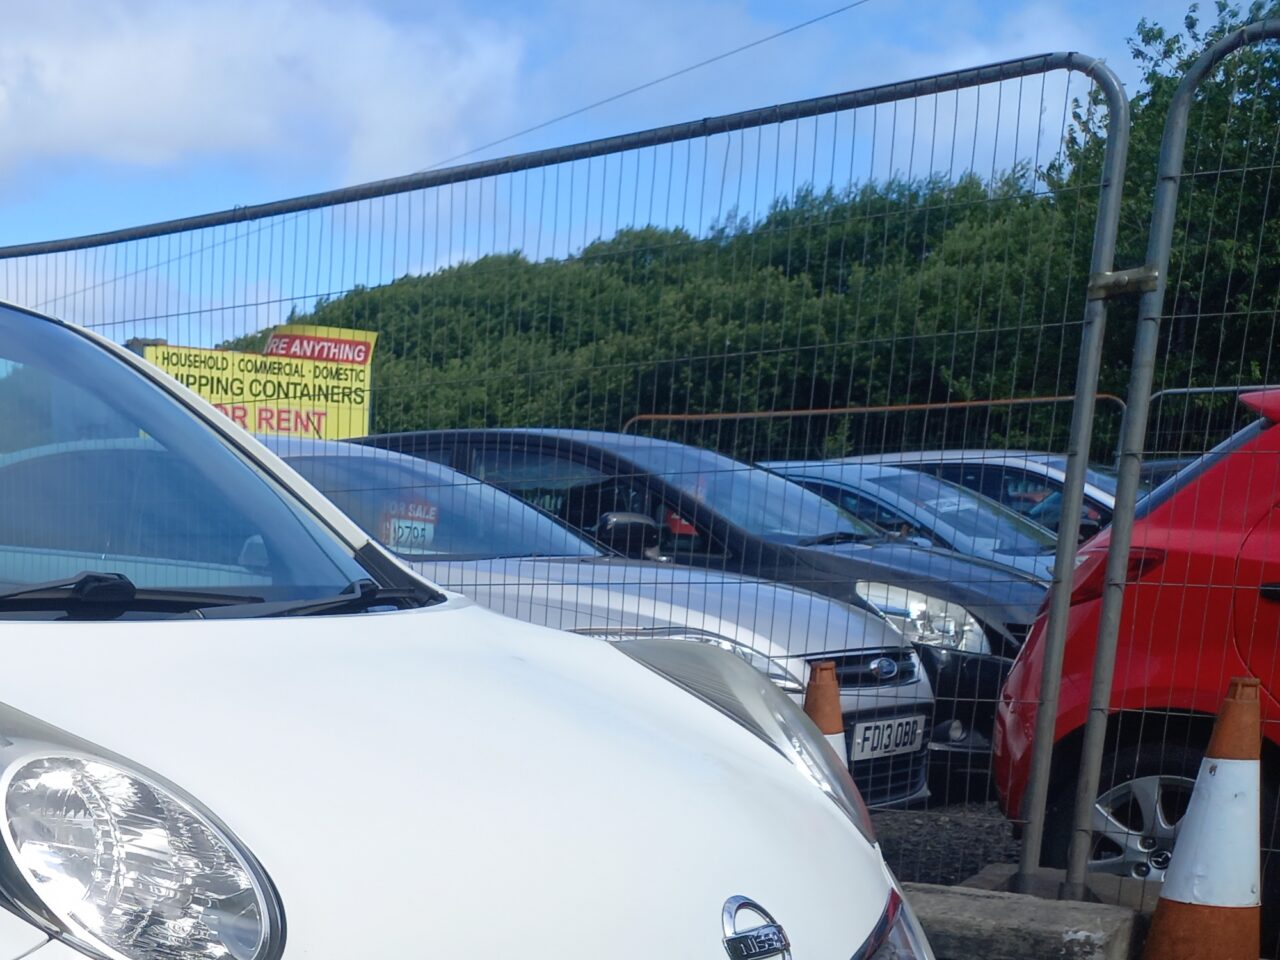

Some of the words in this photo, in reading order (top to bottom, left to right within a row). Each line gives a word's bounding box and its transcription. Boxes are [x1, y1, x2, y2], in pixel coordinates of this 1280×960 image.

[290, 337, 366, 362] ANYTHING
[162, 351, 229, 371] HOUSEHOLD
[238, 358, 305, 378] COMMERCIAL
[314, 365, 365, 382] DOMESTIC
[249, 379, 365, 405] CONTAINERS
[257, 408, 327, 434] RENT
[408, 503, 437, 520] SALE
[861, 723, 893, 753] FD13
